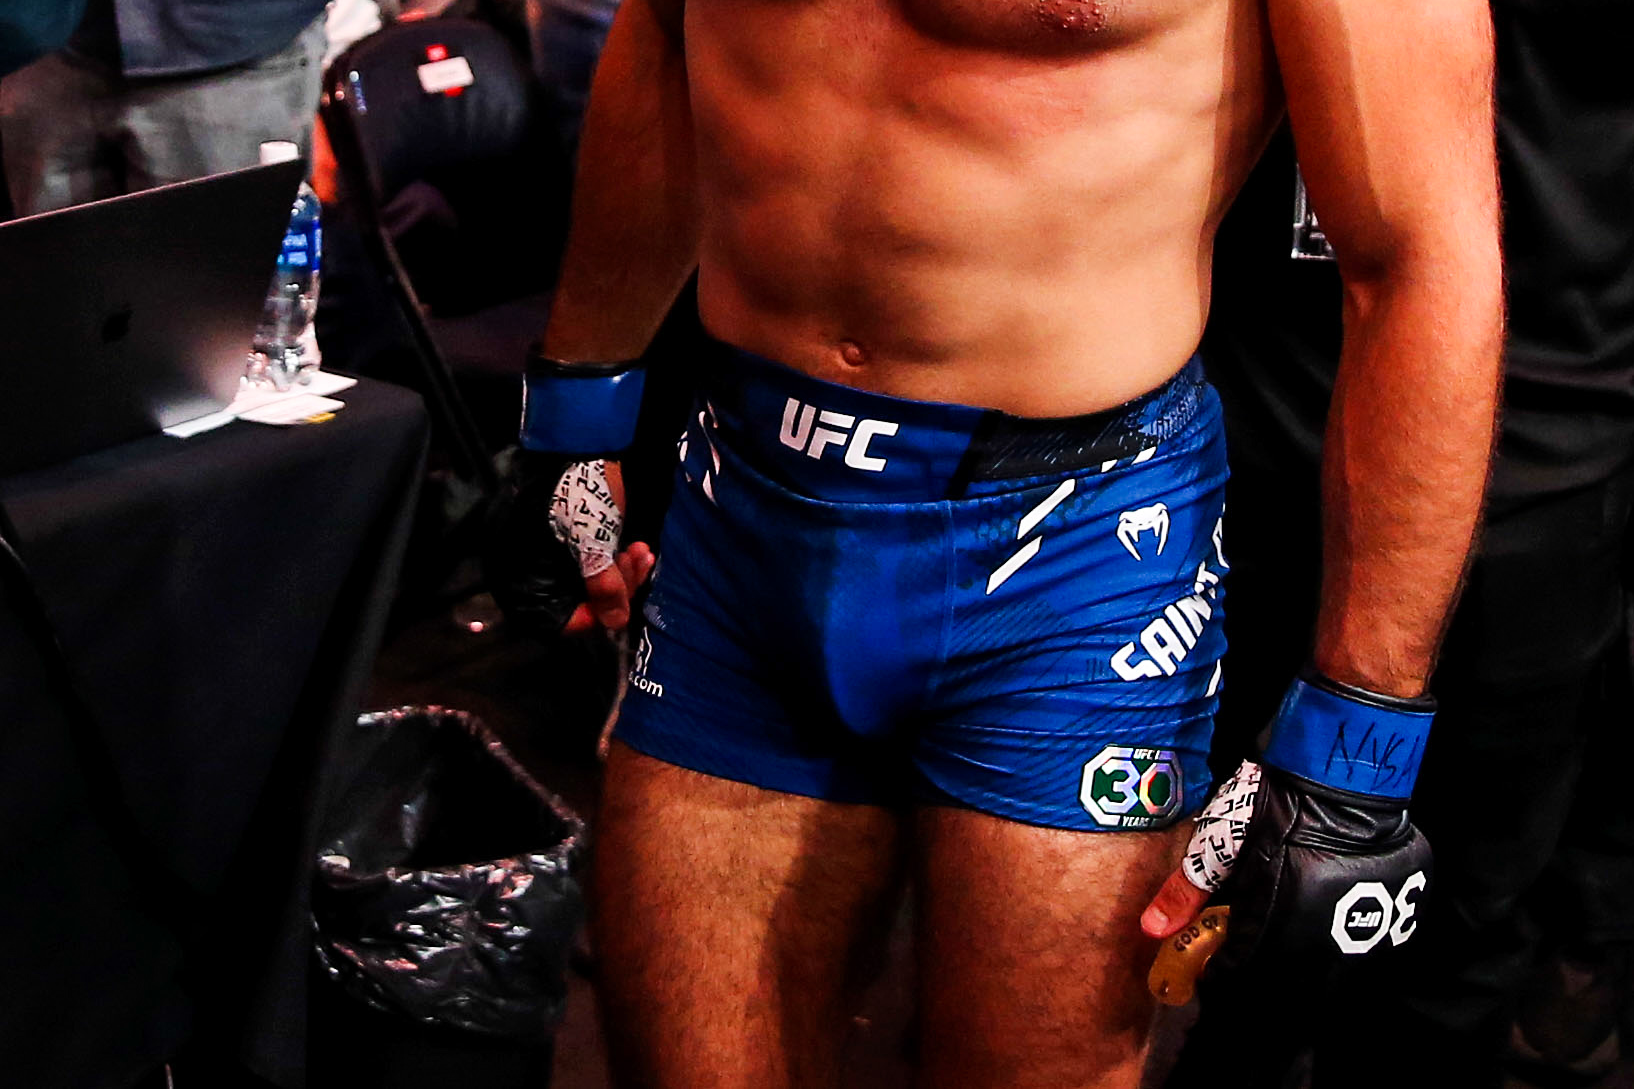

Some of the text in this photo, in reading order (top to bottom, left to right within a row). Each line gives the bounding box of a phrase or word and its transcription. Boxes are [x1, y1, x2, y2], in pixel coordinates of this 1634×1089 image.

[780, 397, 899, 472] UFC
[1110, 561, 1220, 682] SAINT
[1098, 759, 1178, 815] 30
[1348, 911, 1382, 927] UFC
